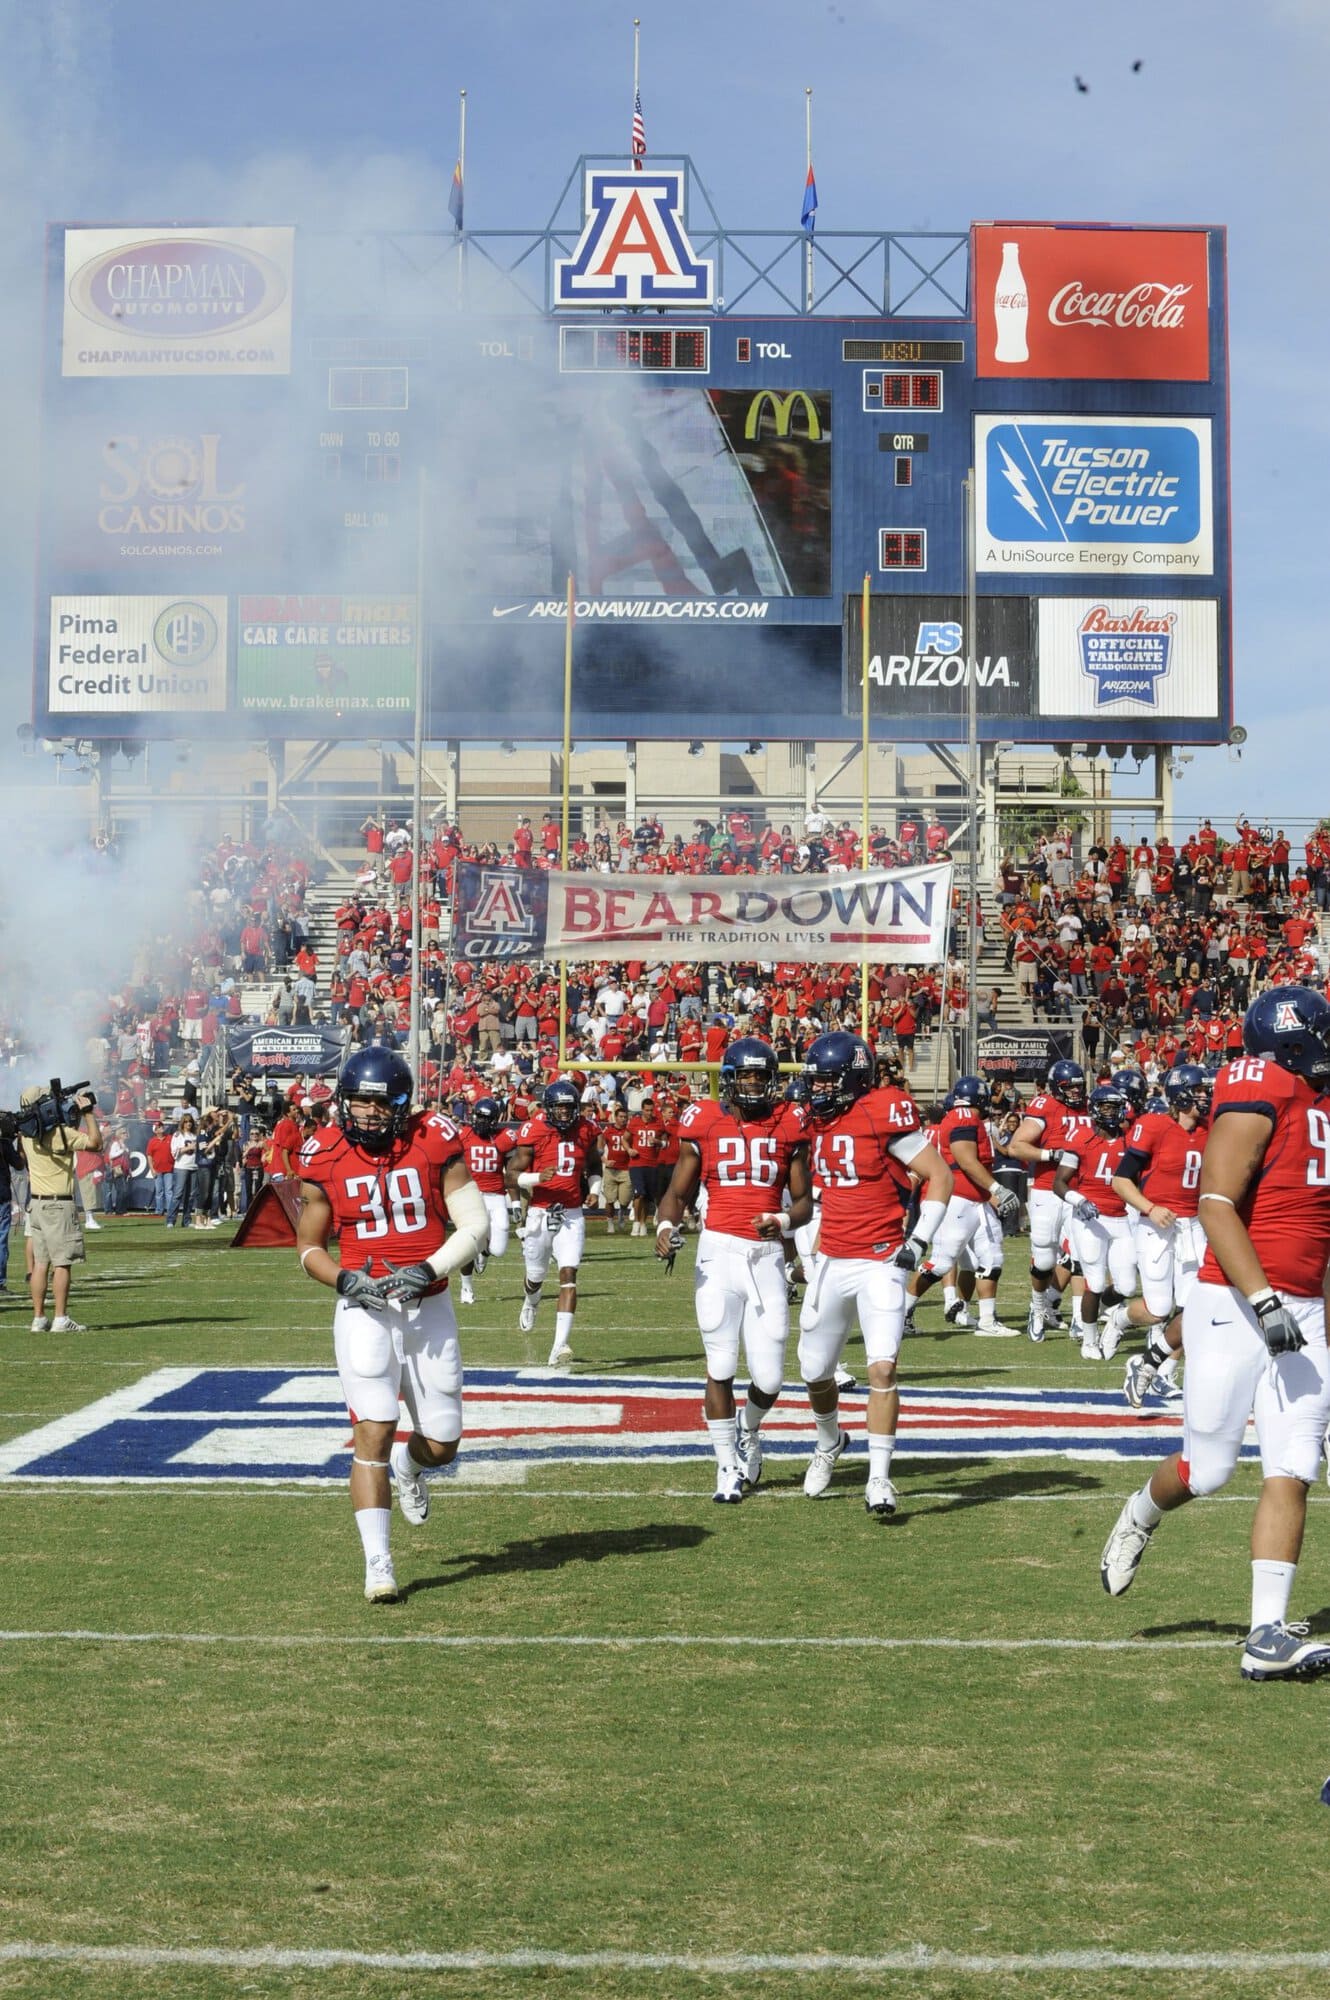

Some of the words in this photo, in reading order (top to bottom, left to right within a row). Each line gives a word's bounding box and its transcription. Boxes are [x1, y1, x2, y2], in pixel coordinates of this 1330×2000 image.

[107, 263, 247, 300] CHAPMAN
[112, 303, 244, 315] AUTOMOTIVE
[1048, 281, 1194, 328] Coca-Cola
[78, 350, 275, 363] CHAPMANTUCSON.COM
[479, 341, 513, 356] TOL
[756, 343, 792, 358] TOL
[882, 343, 921, 361] WSU
[367, 431, 380, 448] TO
[383, 431, 400, 448] GO
[893, 435, 914, 450] QTR
[1041, 439, 1150, 468] Tucson
[1051, 470, 1179, 498] Electric
[98, 504, 246, 533] CASINOS
[1065, 500, 1179, 526] Power
[120, 545, 222, 556] SOLCASINOS.COM
[986, 549, 996, 561] A
[1001, 550, 1074, 563] UniSource
[1079, 551, 1129, 566] Energy
[1132, 551, 1200, 567] Company
[528, 601, 768, 618] ARIZONAWILDCATS.COM
[58, 615, 118, 634] Pima
[1081, 607, 1175, 633] Bashas'
[243, 627, 279, 645] CAR
[284, 627, 329, 645] CARE
[336, 627, 411, 645] CENTERS
[915, 621, 963, 655] FS
[1088, 638, 1164, 650] OFFICIAL
[58, 644, 147, 664] Federal
[1087, 651, 1164, 662] TAILGATE
[860, 655, 1011, 687] ARIZONA
[1088, 663, 1163, 671] HEADQUARTERS
[58, 674, 131, 694] Credit
[137, 674, 209, 694] Union
[1101, 680, 1151, 690] ARIZONA
[242, 695, 410, 709] www.brakemax.com
[669, 931, 694, 942] THE
[700, 932, 783, 943] TRADITION
[786, 932, 825, 943] LIVES
[464, 938, 533, 957] CLUB
[294, 1037, 321, 1045] FAMILY
[1228, 1058, 1266, 1084] 92
[889, 1101, 914, 1127] 43
[521, 1122, 532, 1137] 6
[612, 1135, 625, 1151] 3
[470, 1146, 498, 1173] 52
[557, 1141, 576, 1177] 6
[717, 1137, 779, 1188] 26
[813, 1135, 860, 1188] 43
[1182, 1150, 1202, 1189] 8
[345, 1167, 427, 1240] 38
